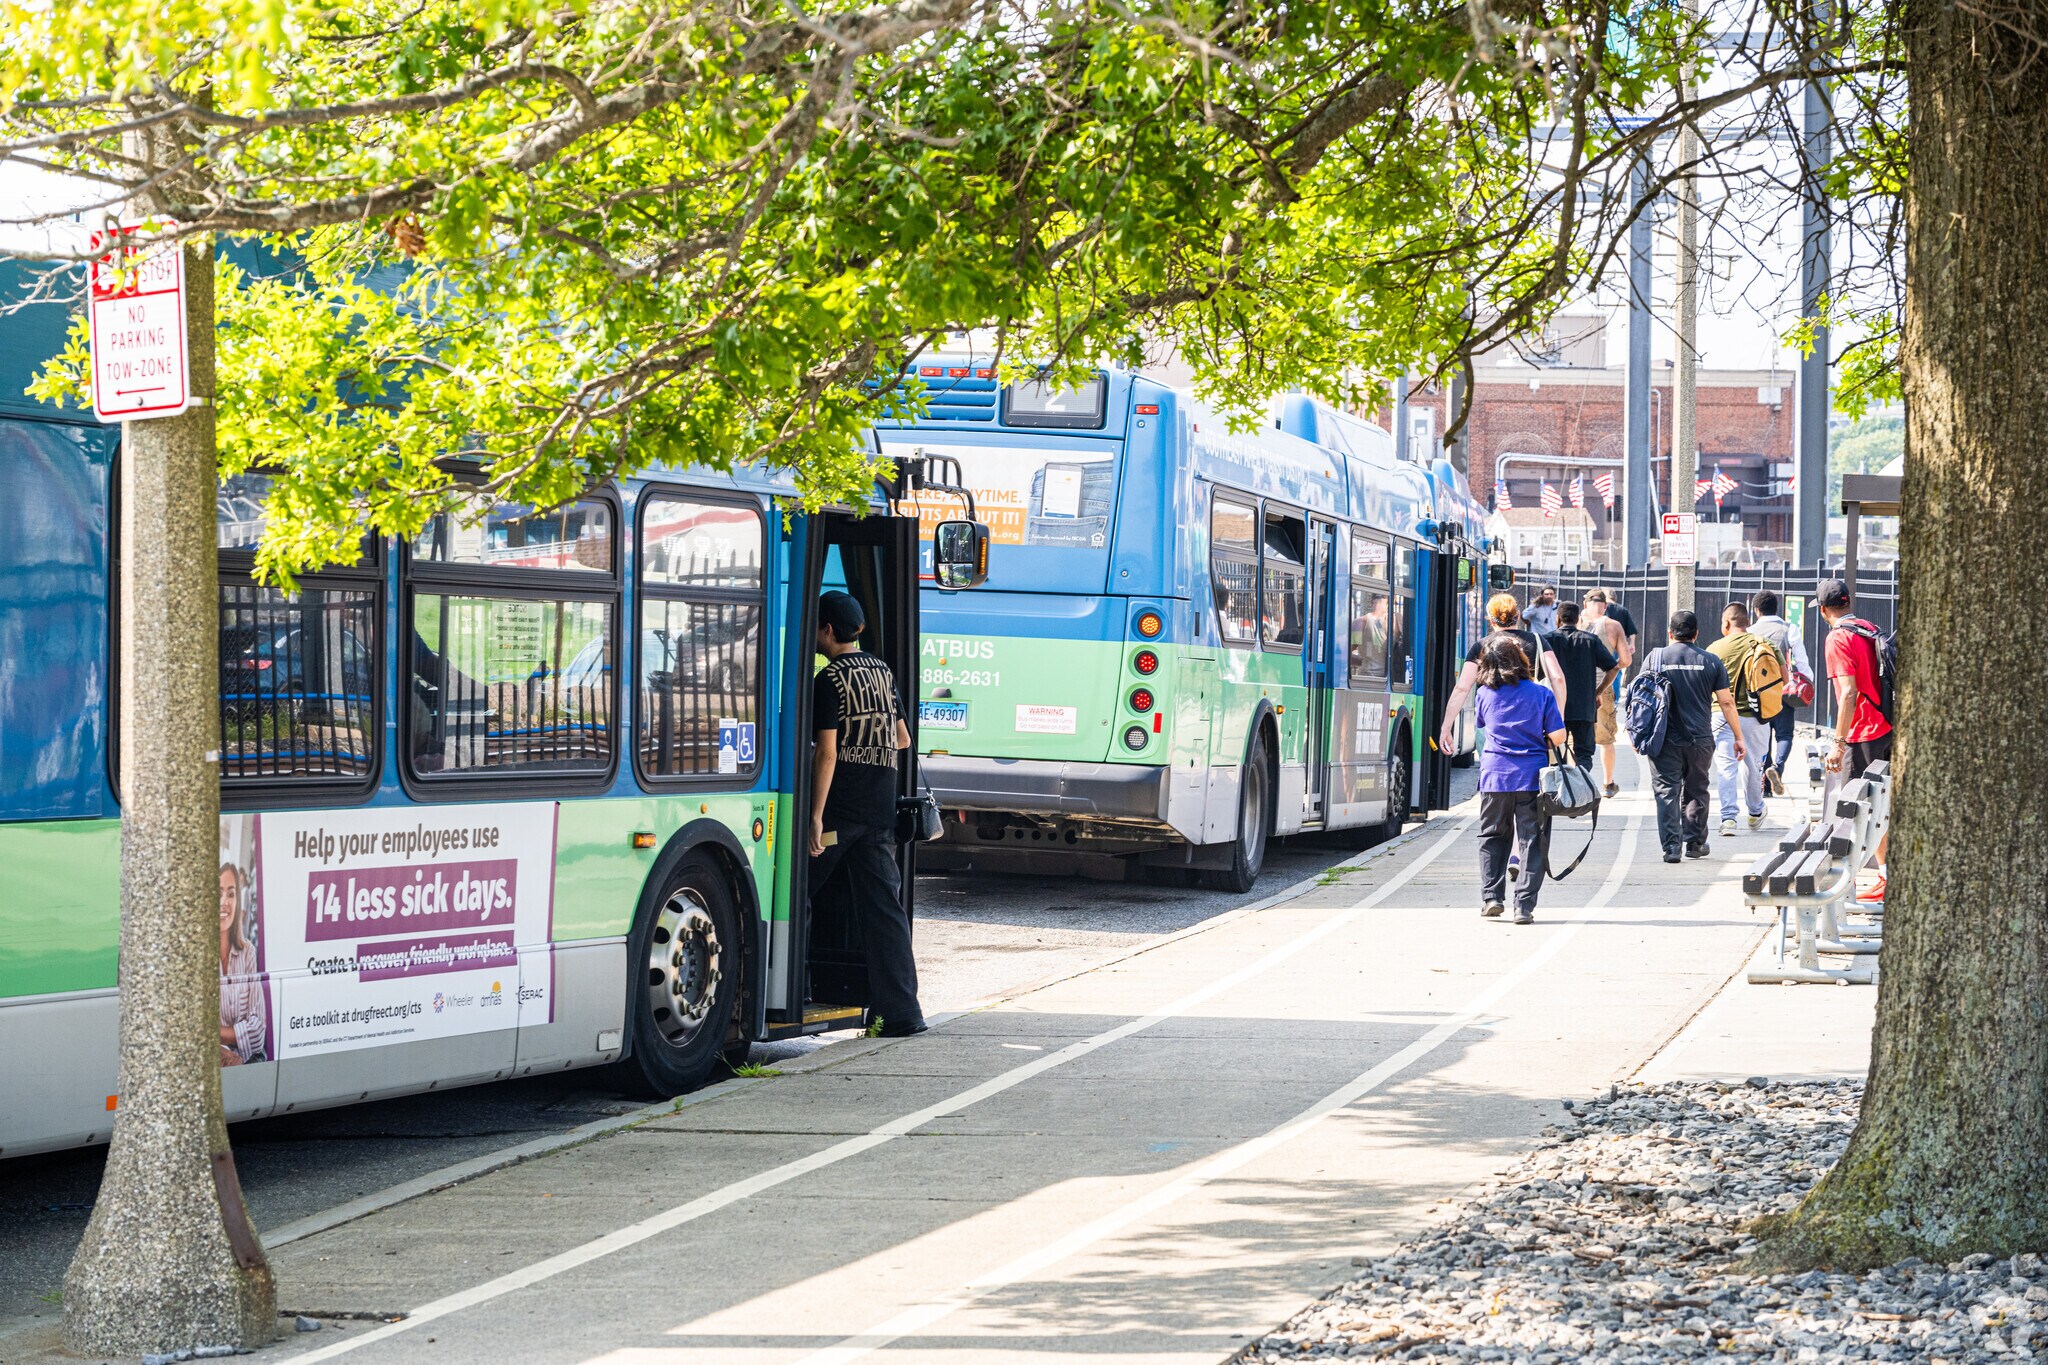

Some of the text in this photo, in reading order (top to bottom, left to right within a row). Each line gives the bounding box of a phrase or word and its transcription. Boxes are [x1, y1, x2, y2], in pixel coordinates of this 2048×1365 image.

[142, 260, 173, 282] STOP
[128, 304, 145, 324] NO
[111, 328, 165, 351] PARKING
[107, 357, 172, 381] TOW-ZONE
[1204, 428, 1243, 466] SOUTHEAST
[946, 509, 998, 524] ABOUT
[1002, 512, 1020, 526] IT!
[990, 528, 1020, 541] k.org
[922, 548, 934, 568] 1
[1029, 707, 1064, 716] WARNING
[294, 823, 499, 864] Help your employees use
[310, 869, 513, 924] 14 less sick days.
[308, 939, 514, 976] Create a recovery friendly workplace.
[446, 994, 474, 1008] Wheeler
[521, 988, 543, 1000] SERAC
[290, 1000, 422, 1030] Get a toolkit at drugfreect.org/cts
